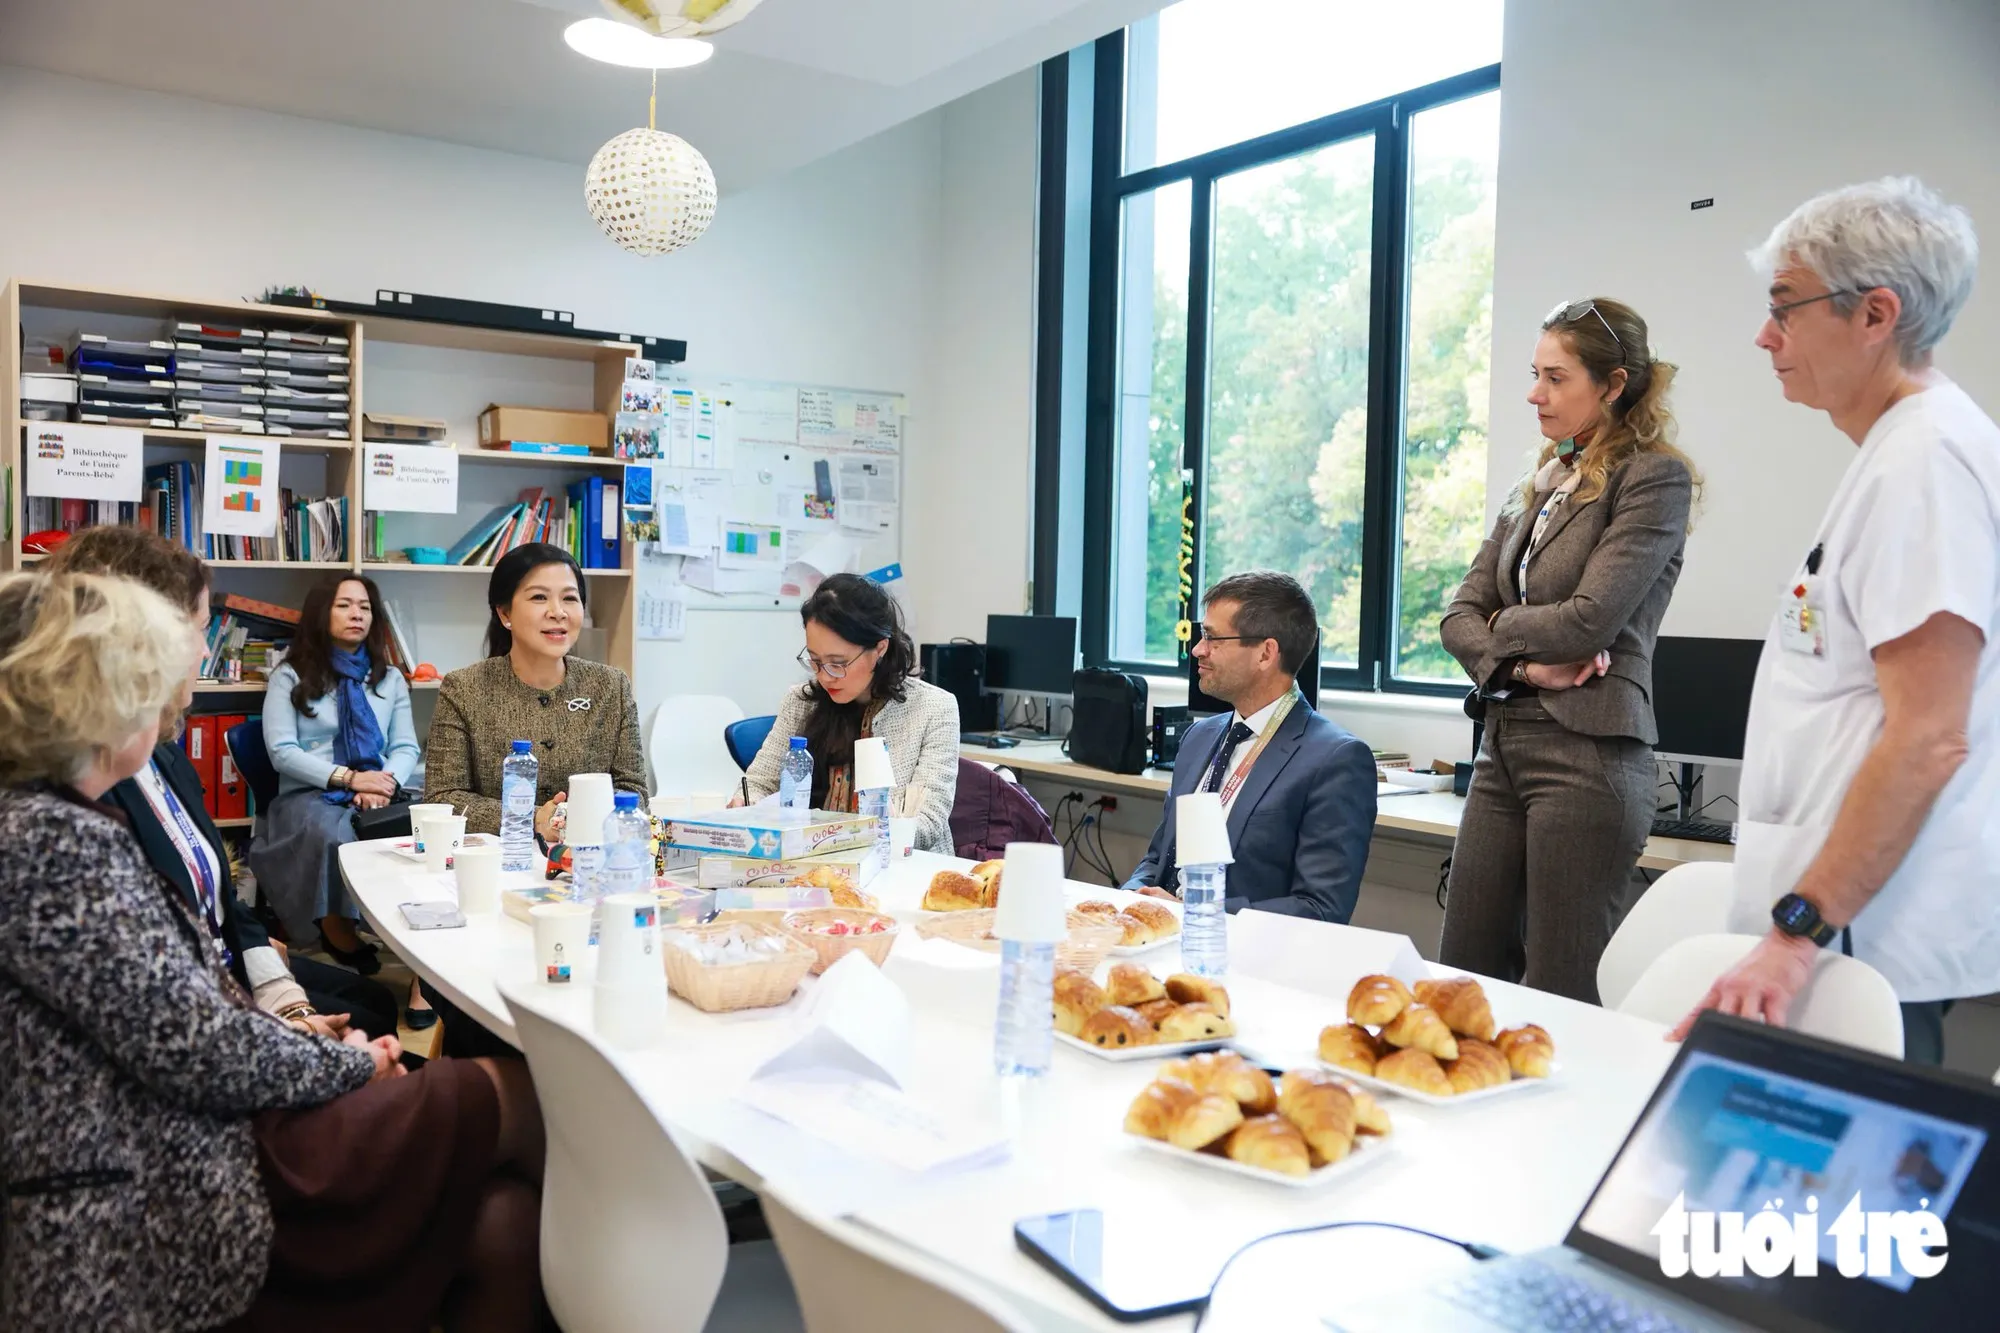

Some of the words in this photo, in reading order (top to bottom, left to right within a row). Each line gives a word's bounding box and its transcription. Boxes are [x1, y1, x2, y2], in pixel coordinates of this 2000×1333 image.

[73, 448, 128, 460] Bibliothèque
[93, 460, 121, 469] l'unité
[57, 469, 115, 480] Parents-Bébé
